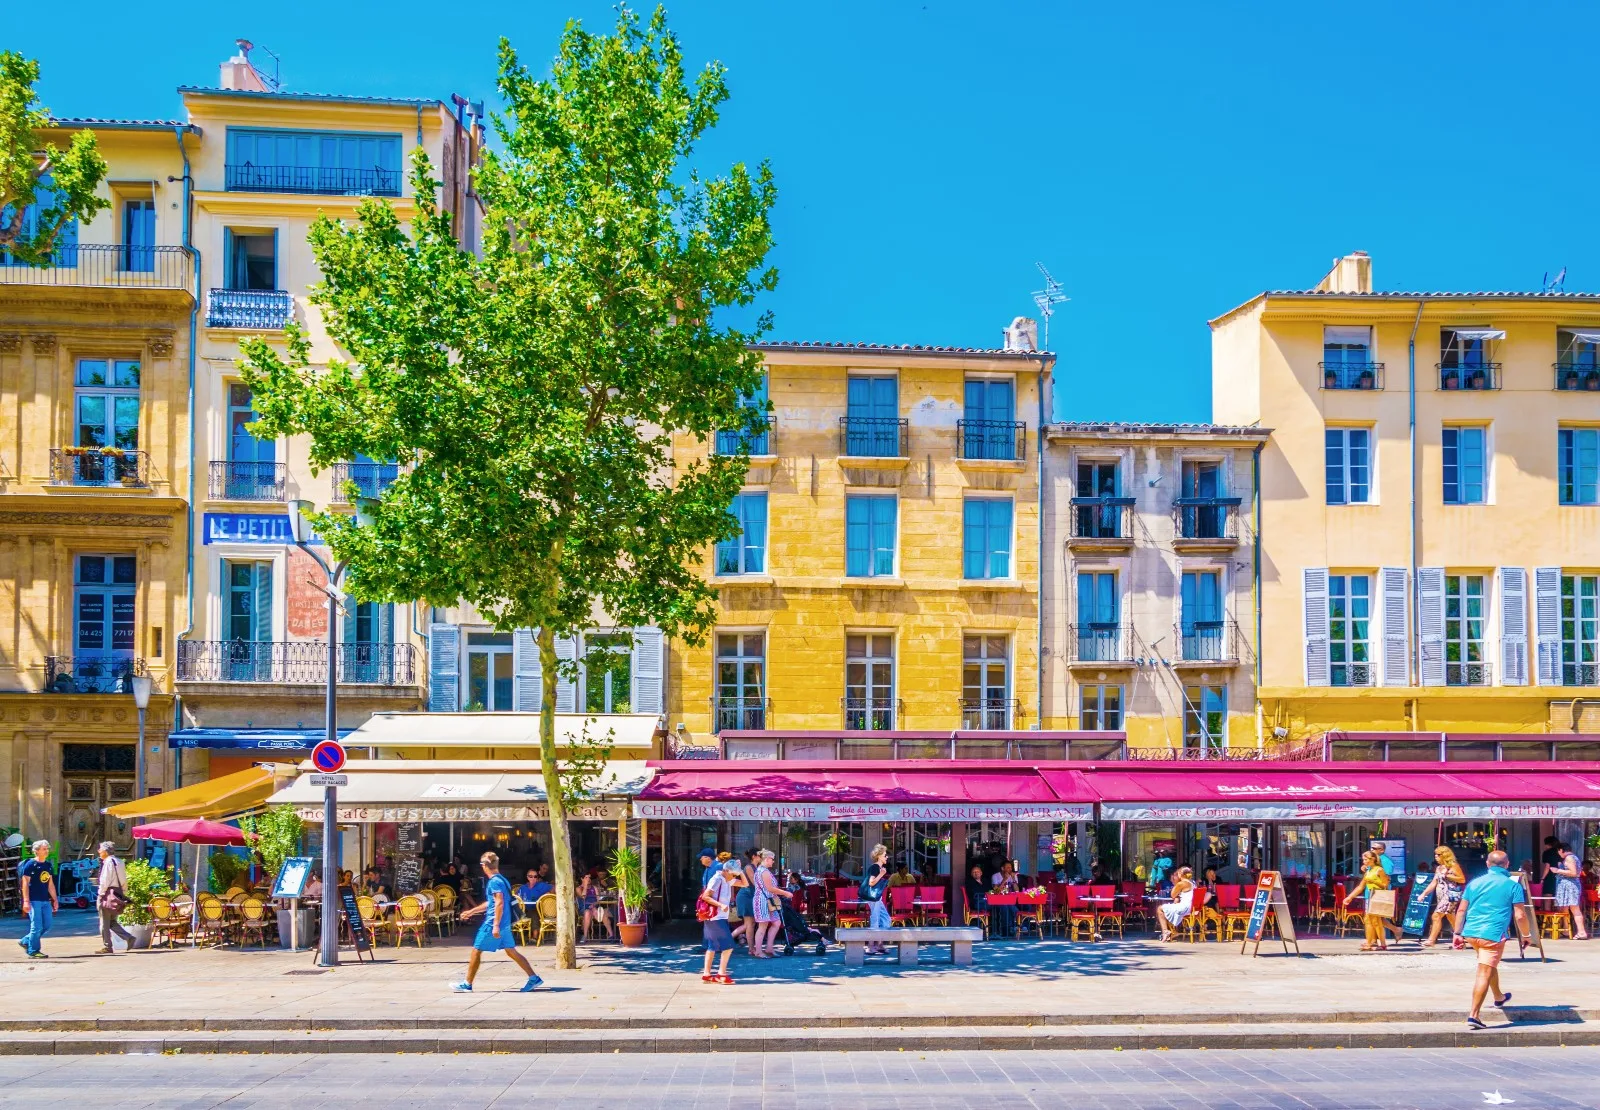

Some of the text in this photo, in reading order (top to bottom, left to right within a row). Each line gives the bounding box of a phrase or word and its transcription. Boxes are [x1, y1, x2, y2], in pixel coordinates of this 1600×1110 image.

[210, 517, 230, 539] LE
[237, 518, 288, 540] PETIT
[383, 807, 513, 819] RESTAURANT
[571, 805, 609, 818] Café
[641, 804, 817, 819] CHAMBRES de CHARME
[829, 805, 888, 814] Bastide du Cours
[901, 807, 1085, 819] BRASSERIE RESTAURANT
[1149, 806, 1245, 818] Service Continu
[1297, 803, 1354, 812] Bastide du Cours
[1403, 805, 1466, 816] GLACIER
